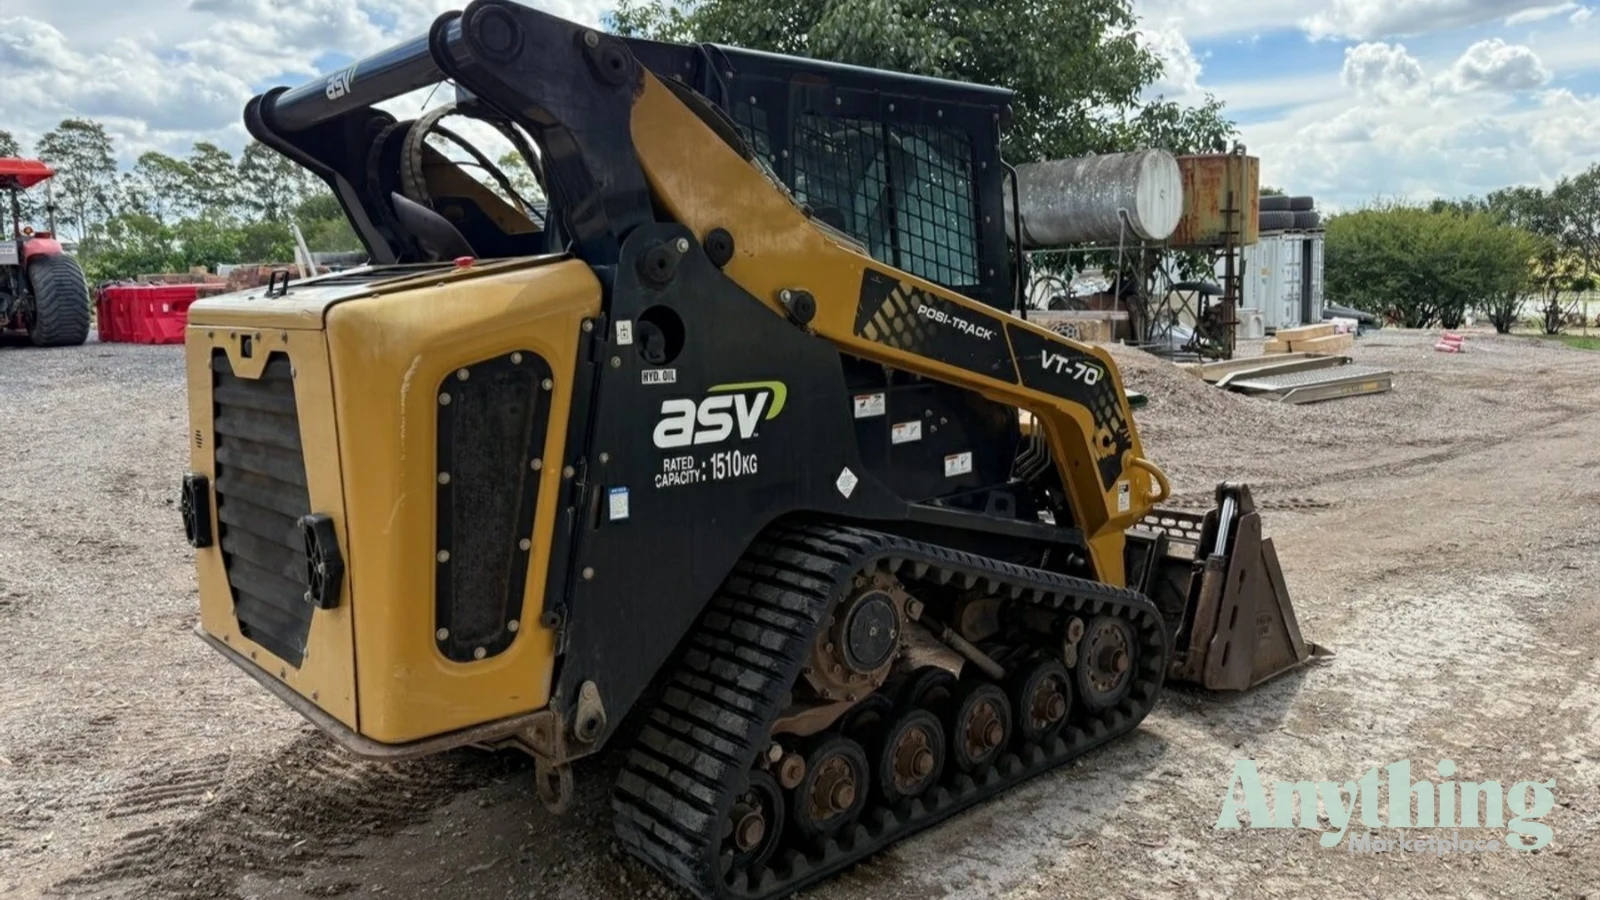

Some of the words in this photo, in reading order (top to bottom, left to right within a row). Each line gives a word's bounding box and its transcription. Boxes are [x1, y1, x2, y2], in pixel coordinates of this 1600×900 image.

[917, 304, 993, 341] POSI-TRACK
[1040, 349, 1099, 386] VT-70
[663, 456, 694, 472] RATED
